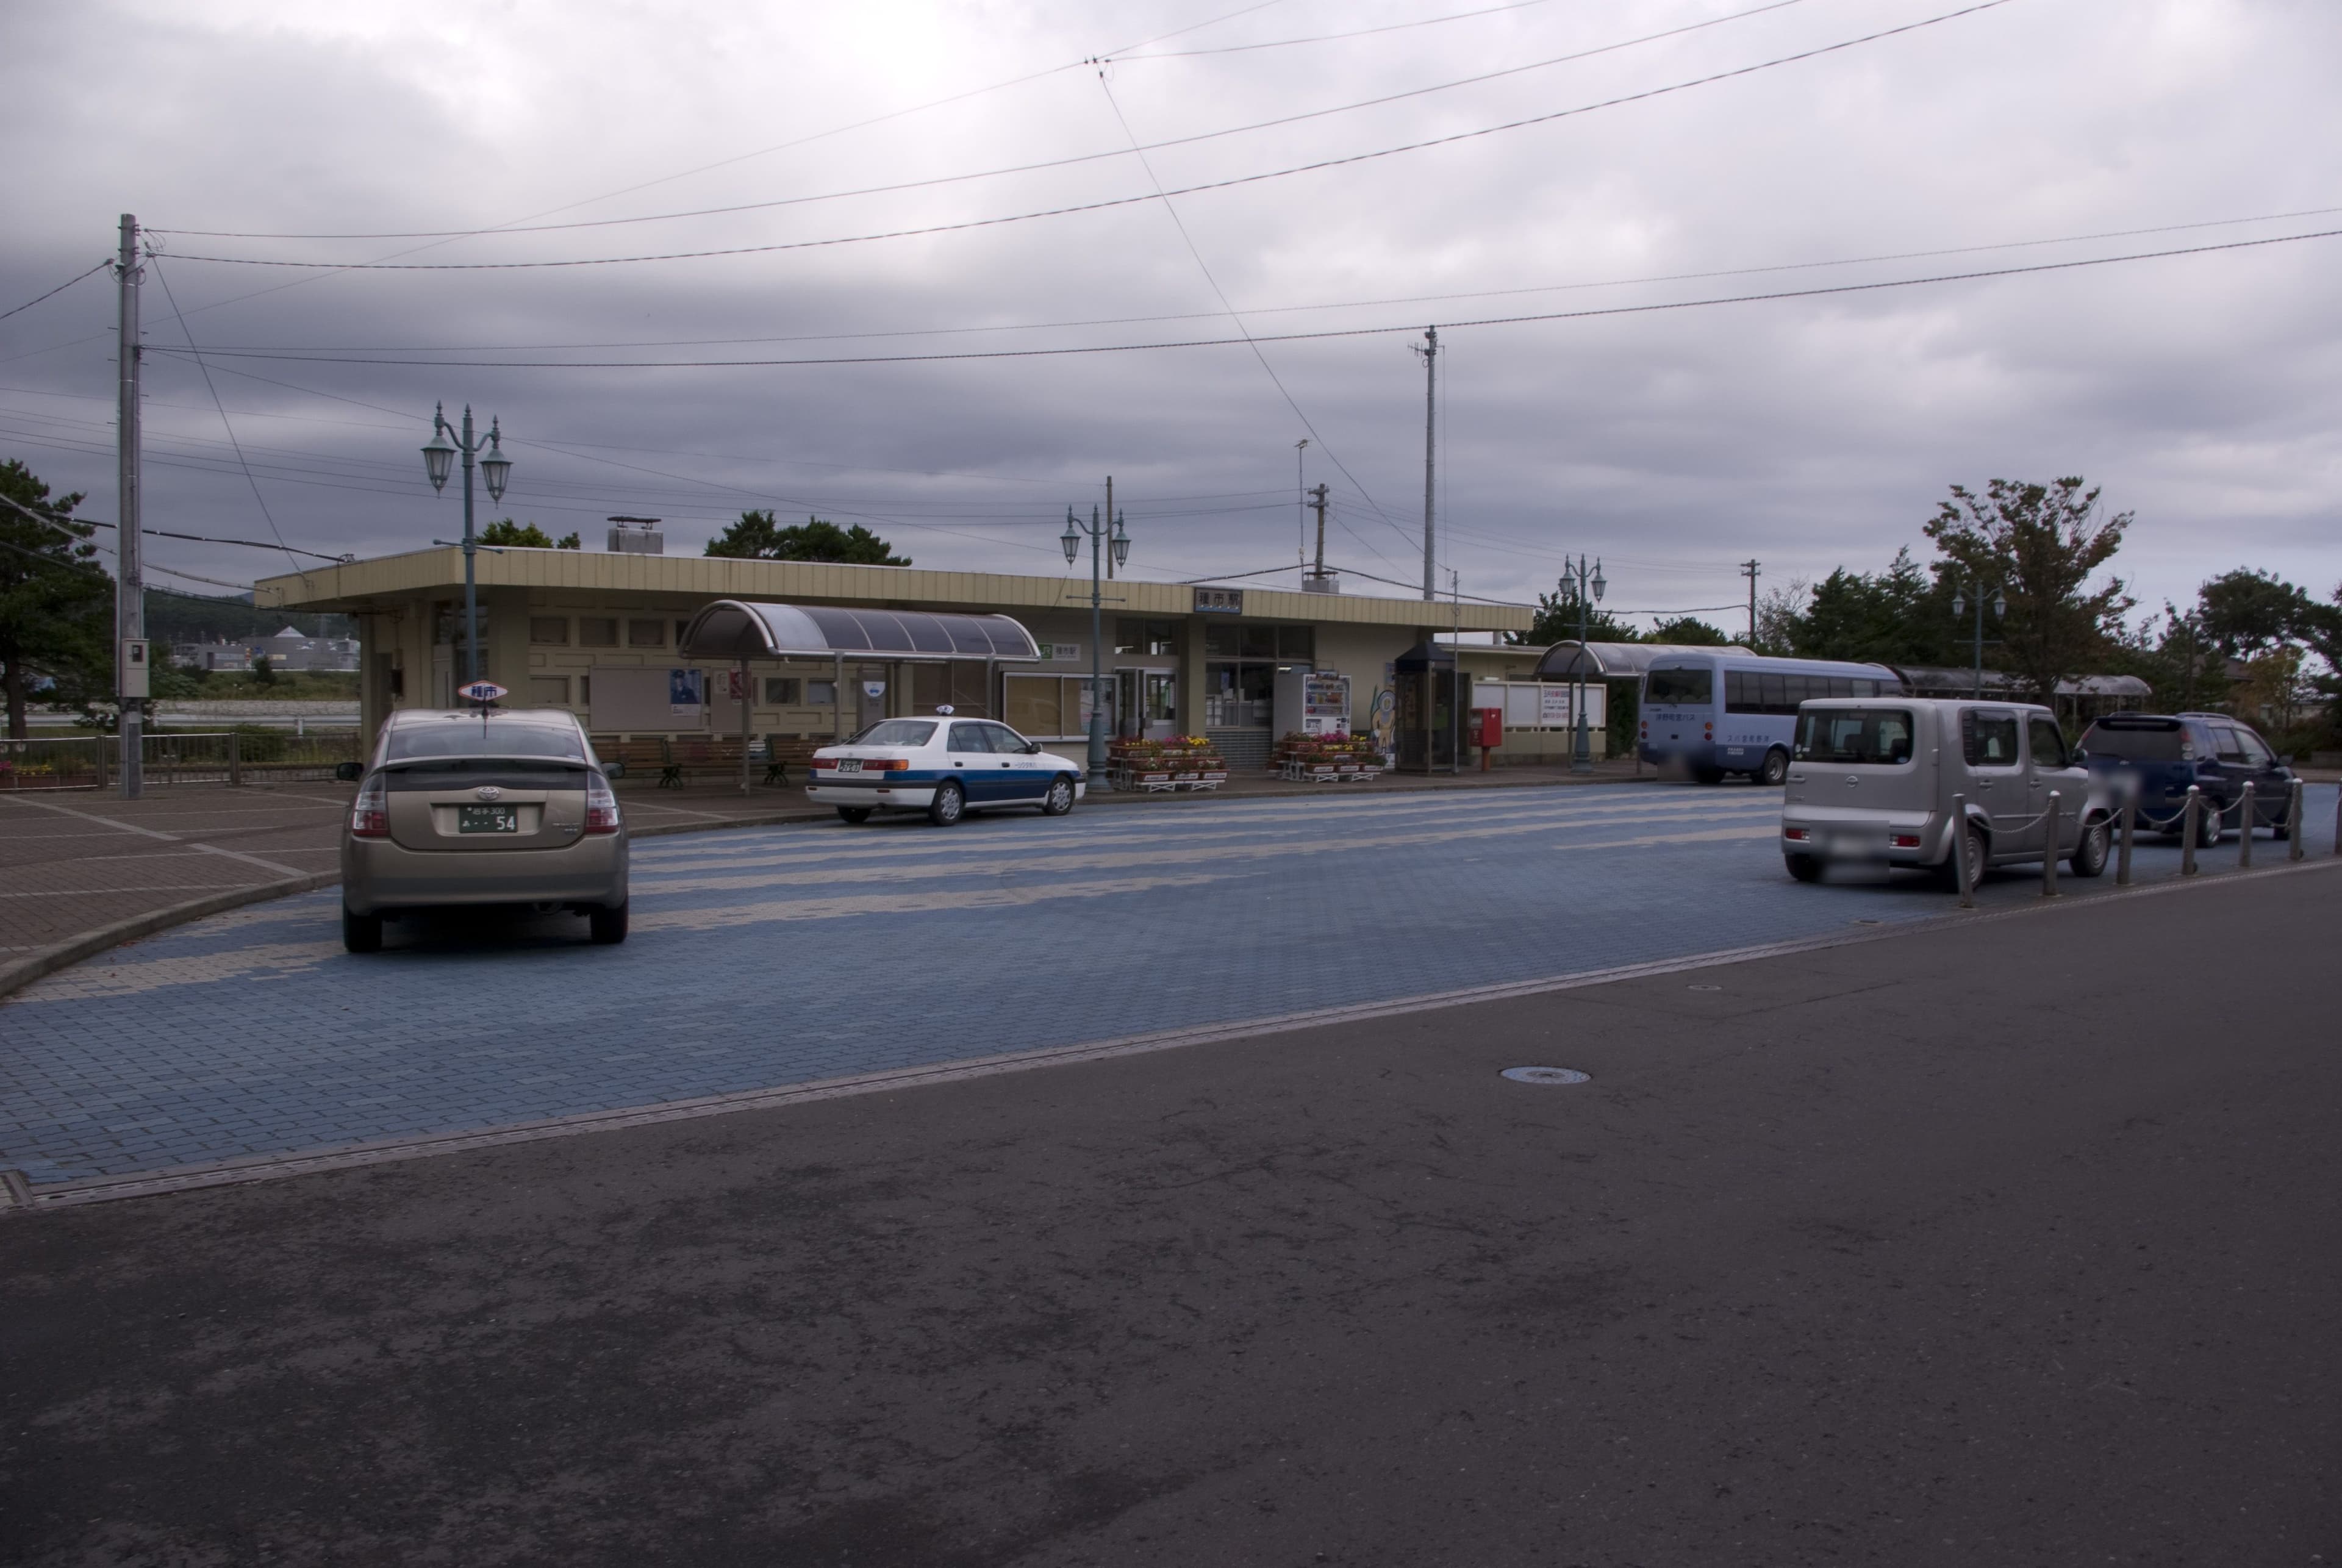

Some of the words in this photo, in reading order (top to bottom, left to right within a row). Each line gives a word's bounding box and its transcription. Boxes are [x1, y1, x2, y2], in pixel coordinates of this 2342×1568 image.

[1199, 592, 1240, 606] 種市駅
[471, 686, 497, 697] 種市
